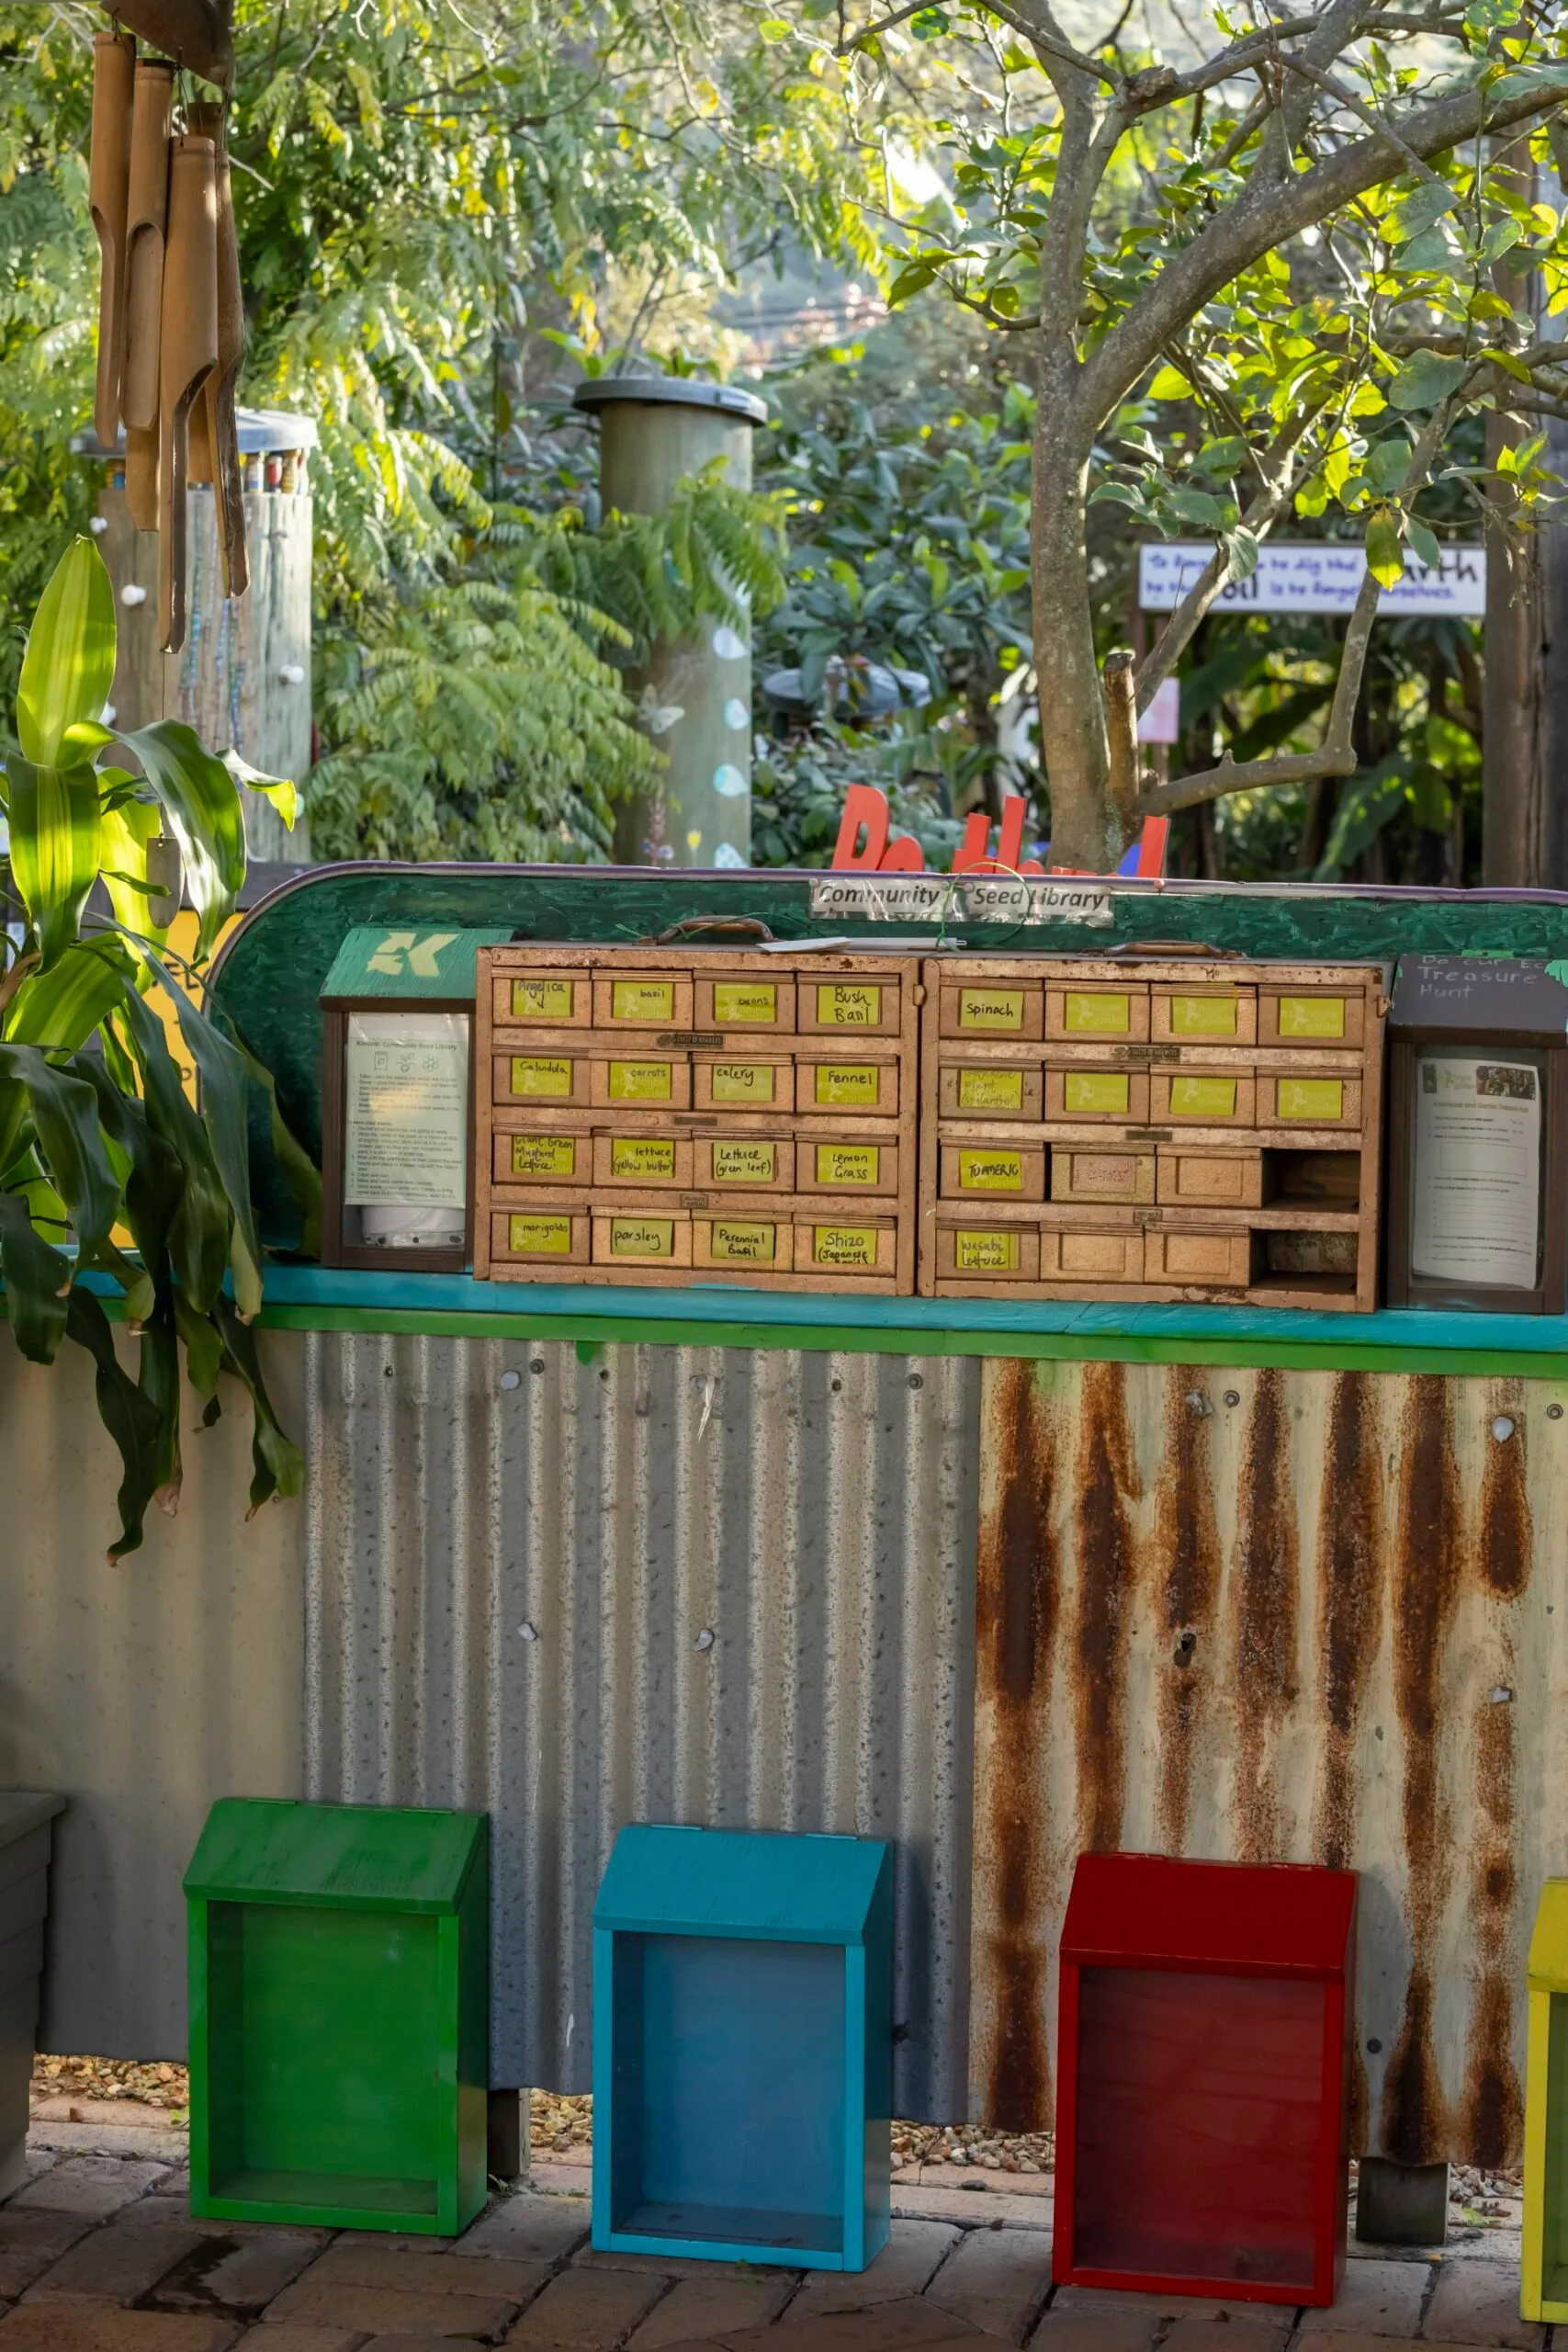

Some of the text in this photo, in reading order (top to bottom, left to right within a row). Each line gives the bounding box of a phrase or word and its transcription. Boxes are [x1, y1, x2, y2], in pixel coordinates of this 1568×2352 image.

[1401, 548, 1480, 583] arth
[1222, 572, 1259, 601] oil
[821, 884, 1105, 911] Community Seed Library
[1416, 966, 1540, 985] Treasure
[517, 979, 566, 1009] Angelica
[639, 988, 665, 999] basil
[834, 986, 872, 1006] Bush
[1419, 983, 1474, 999] Hunt
[965, 1002, 1014, 1019] Spinach
[716, 1066, 755, 1086] celery
[828, 1070, 873, 1085] Fennel
[635, 1147, 671, 1157] lettuce
[720, 1148, 761, 1159] Lettuce
[832, 1153, 869, 1164] Lemon
[716, 1160, 741, 1177] (green
[834, 1165, 868, 1180] Grass
[523, 1222, 569, 1238] marigolds
[719, 1228, 765, 1244] Perennial
[614, 1227, 660, 1250] parsley
[824, 1232, 865, 1248] Shizo
